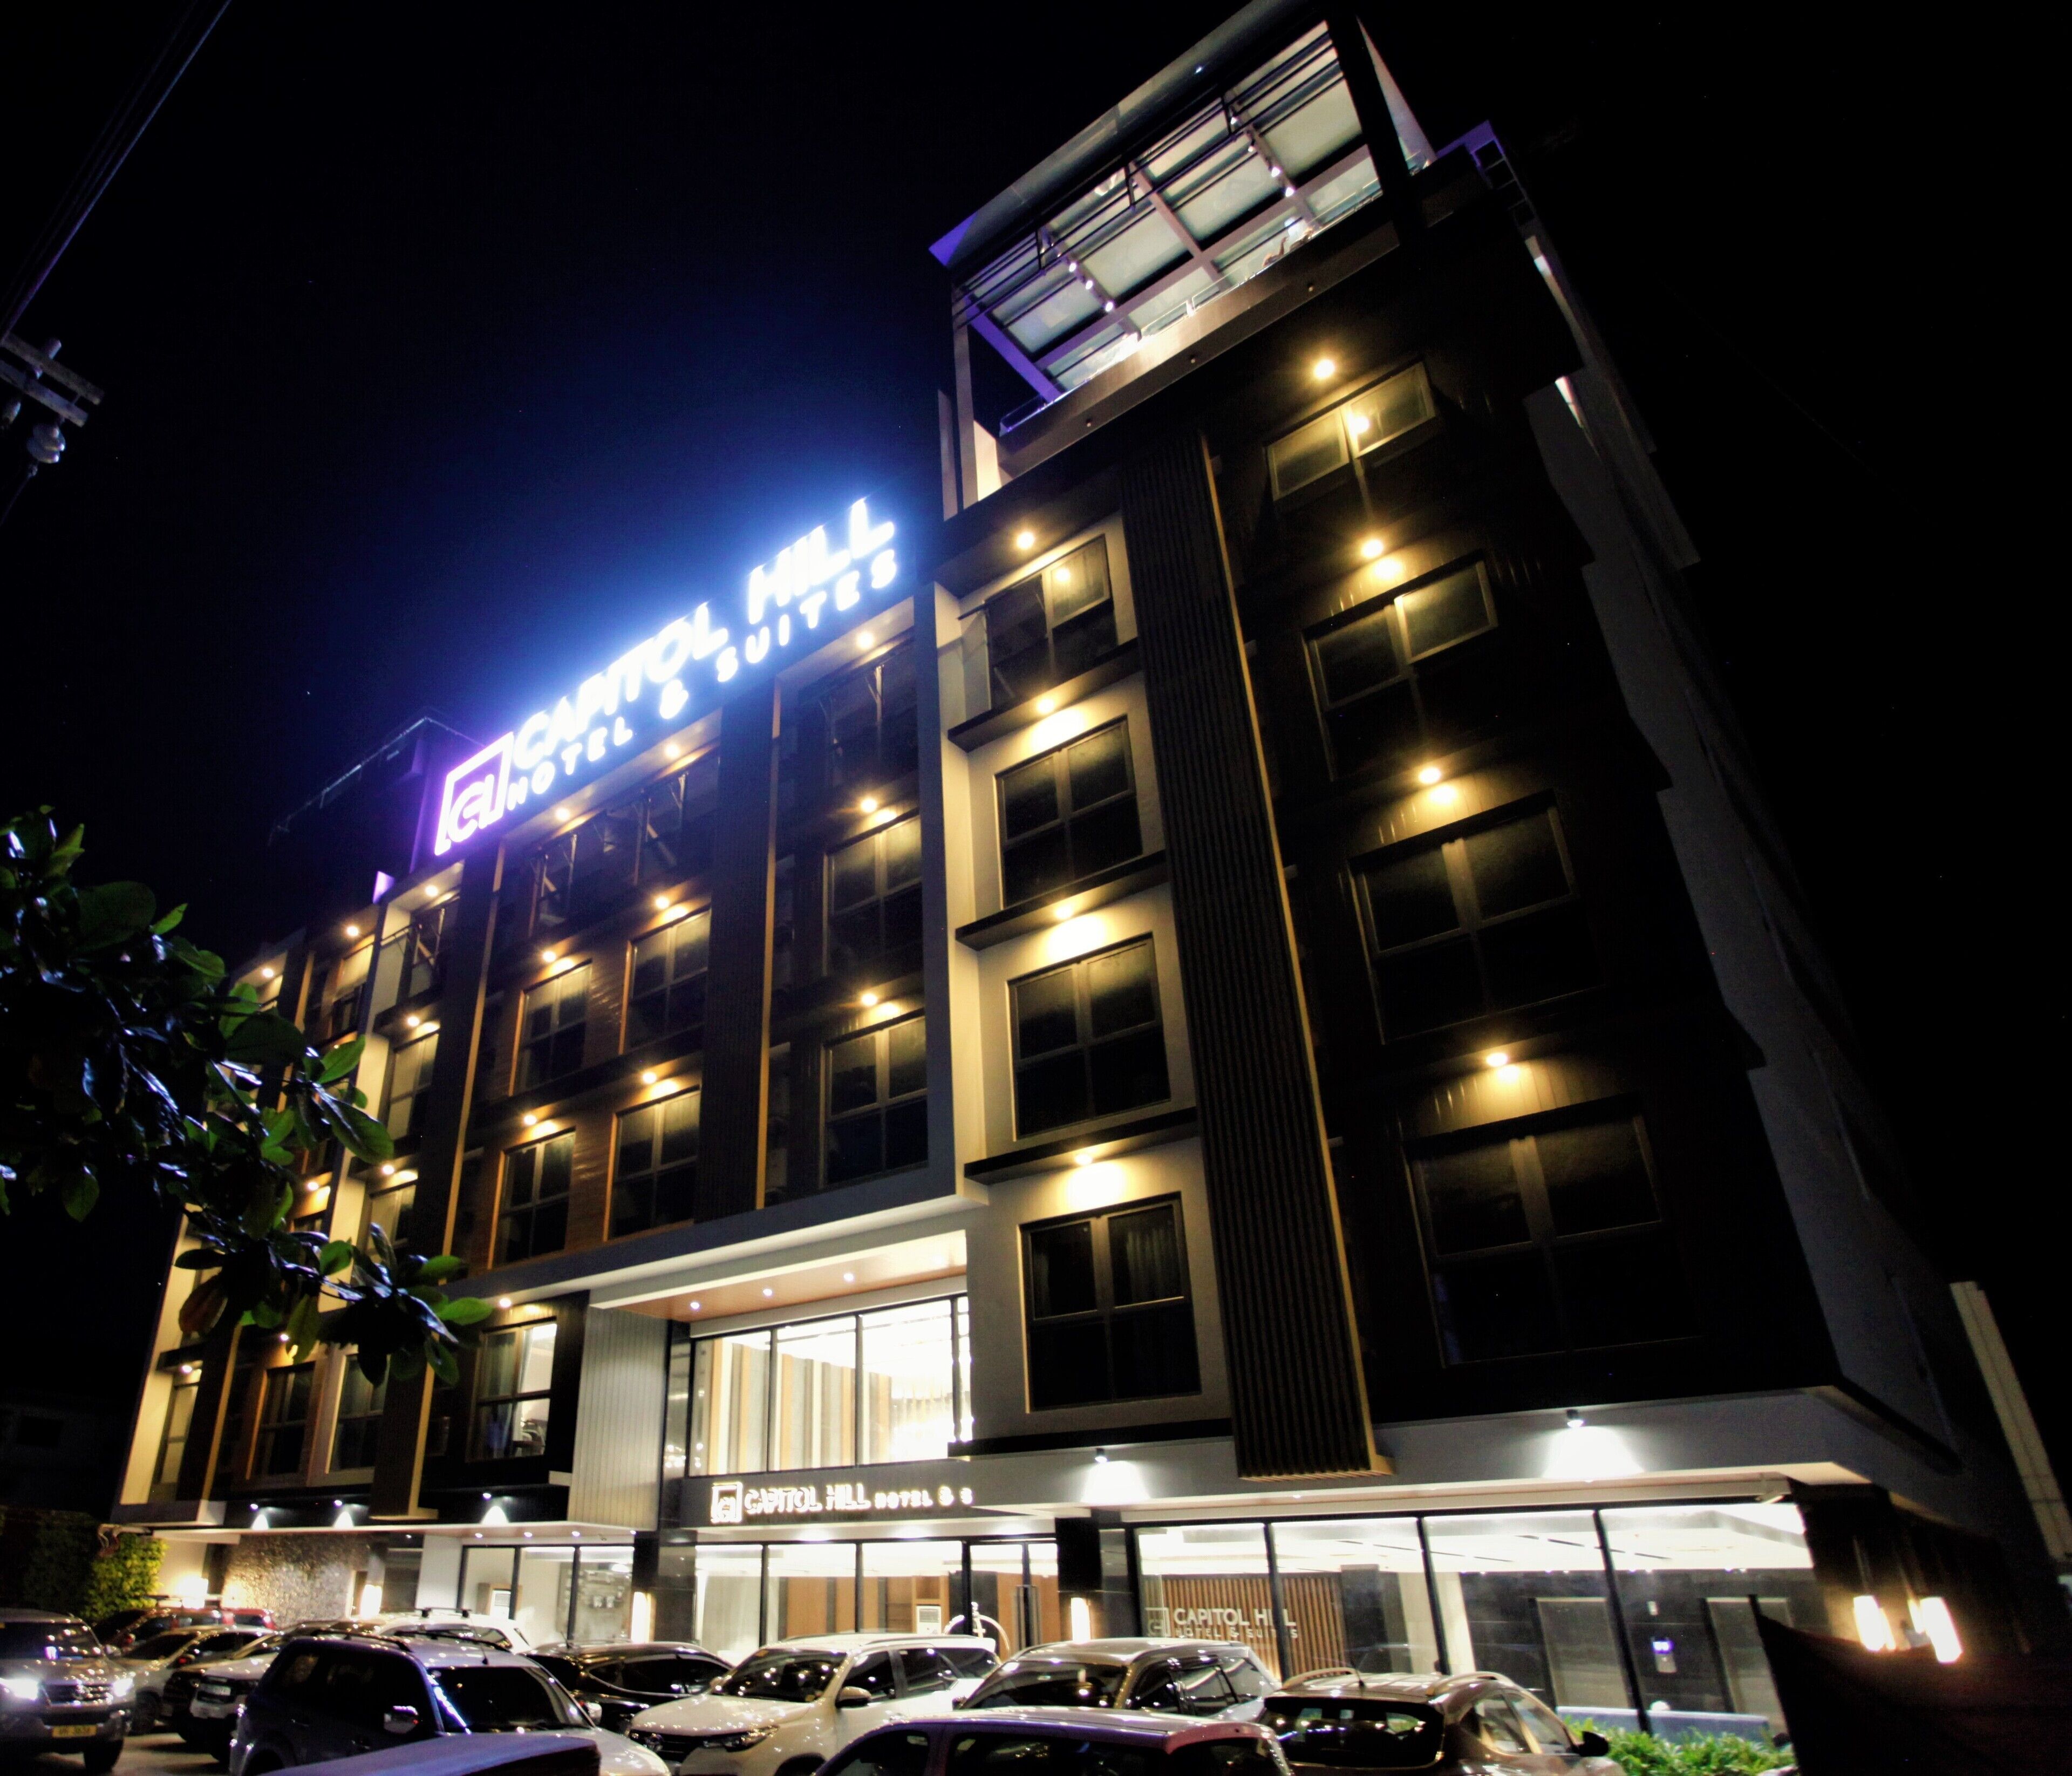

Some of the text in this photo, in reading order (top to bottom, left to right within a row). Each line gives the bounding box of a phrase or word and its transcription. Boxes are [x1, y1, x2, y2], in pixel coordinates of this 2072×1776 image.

[513, 497, 895, 770] CAPITOL HILL
[507, 548, 897, 811] HOTEL & SUITES
[744, 1486, 823, 1514] CAPITOL
[825, 1482, 872, 1510] HILL
[874, 1489, 933, 1509] HOTEL
[1174, 1608, 1250, 1626] CAPITOL
[1254, 1608, 1296, 1626] HIL
[1176, 1627, 1298, 1638] HOTEL & SUITS
